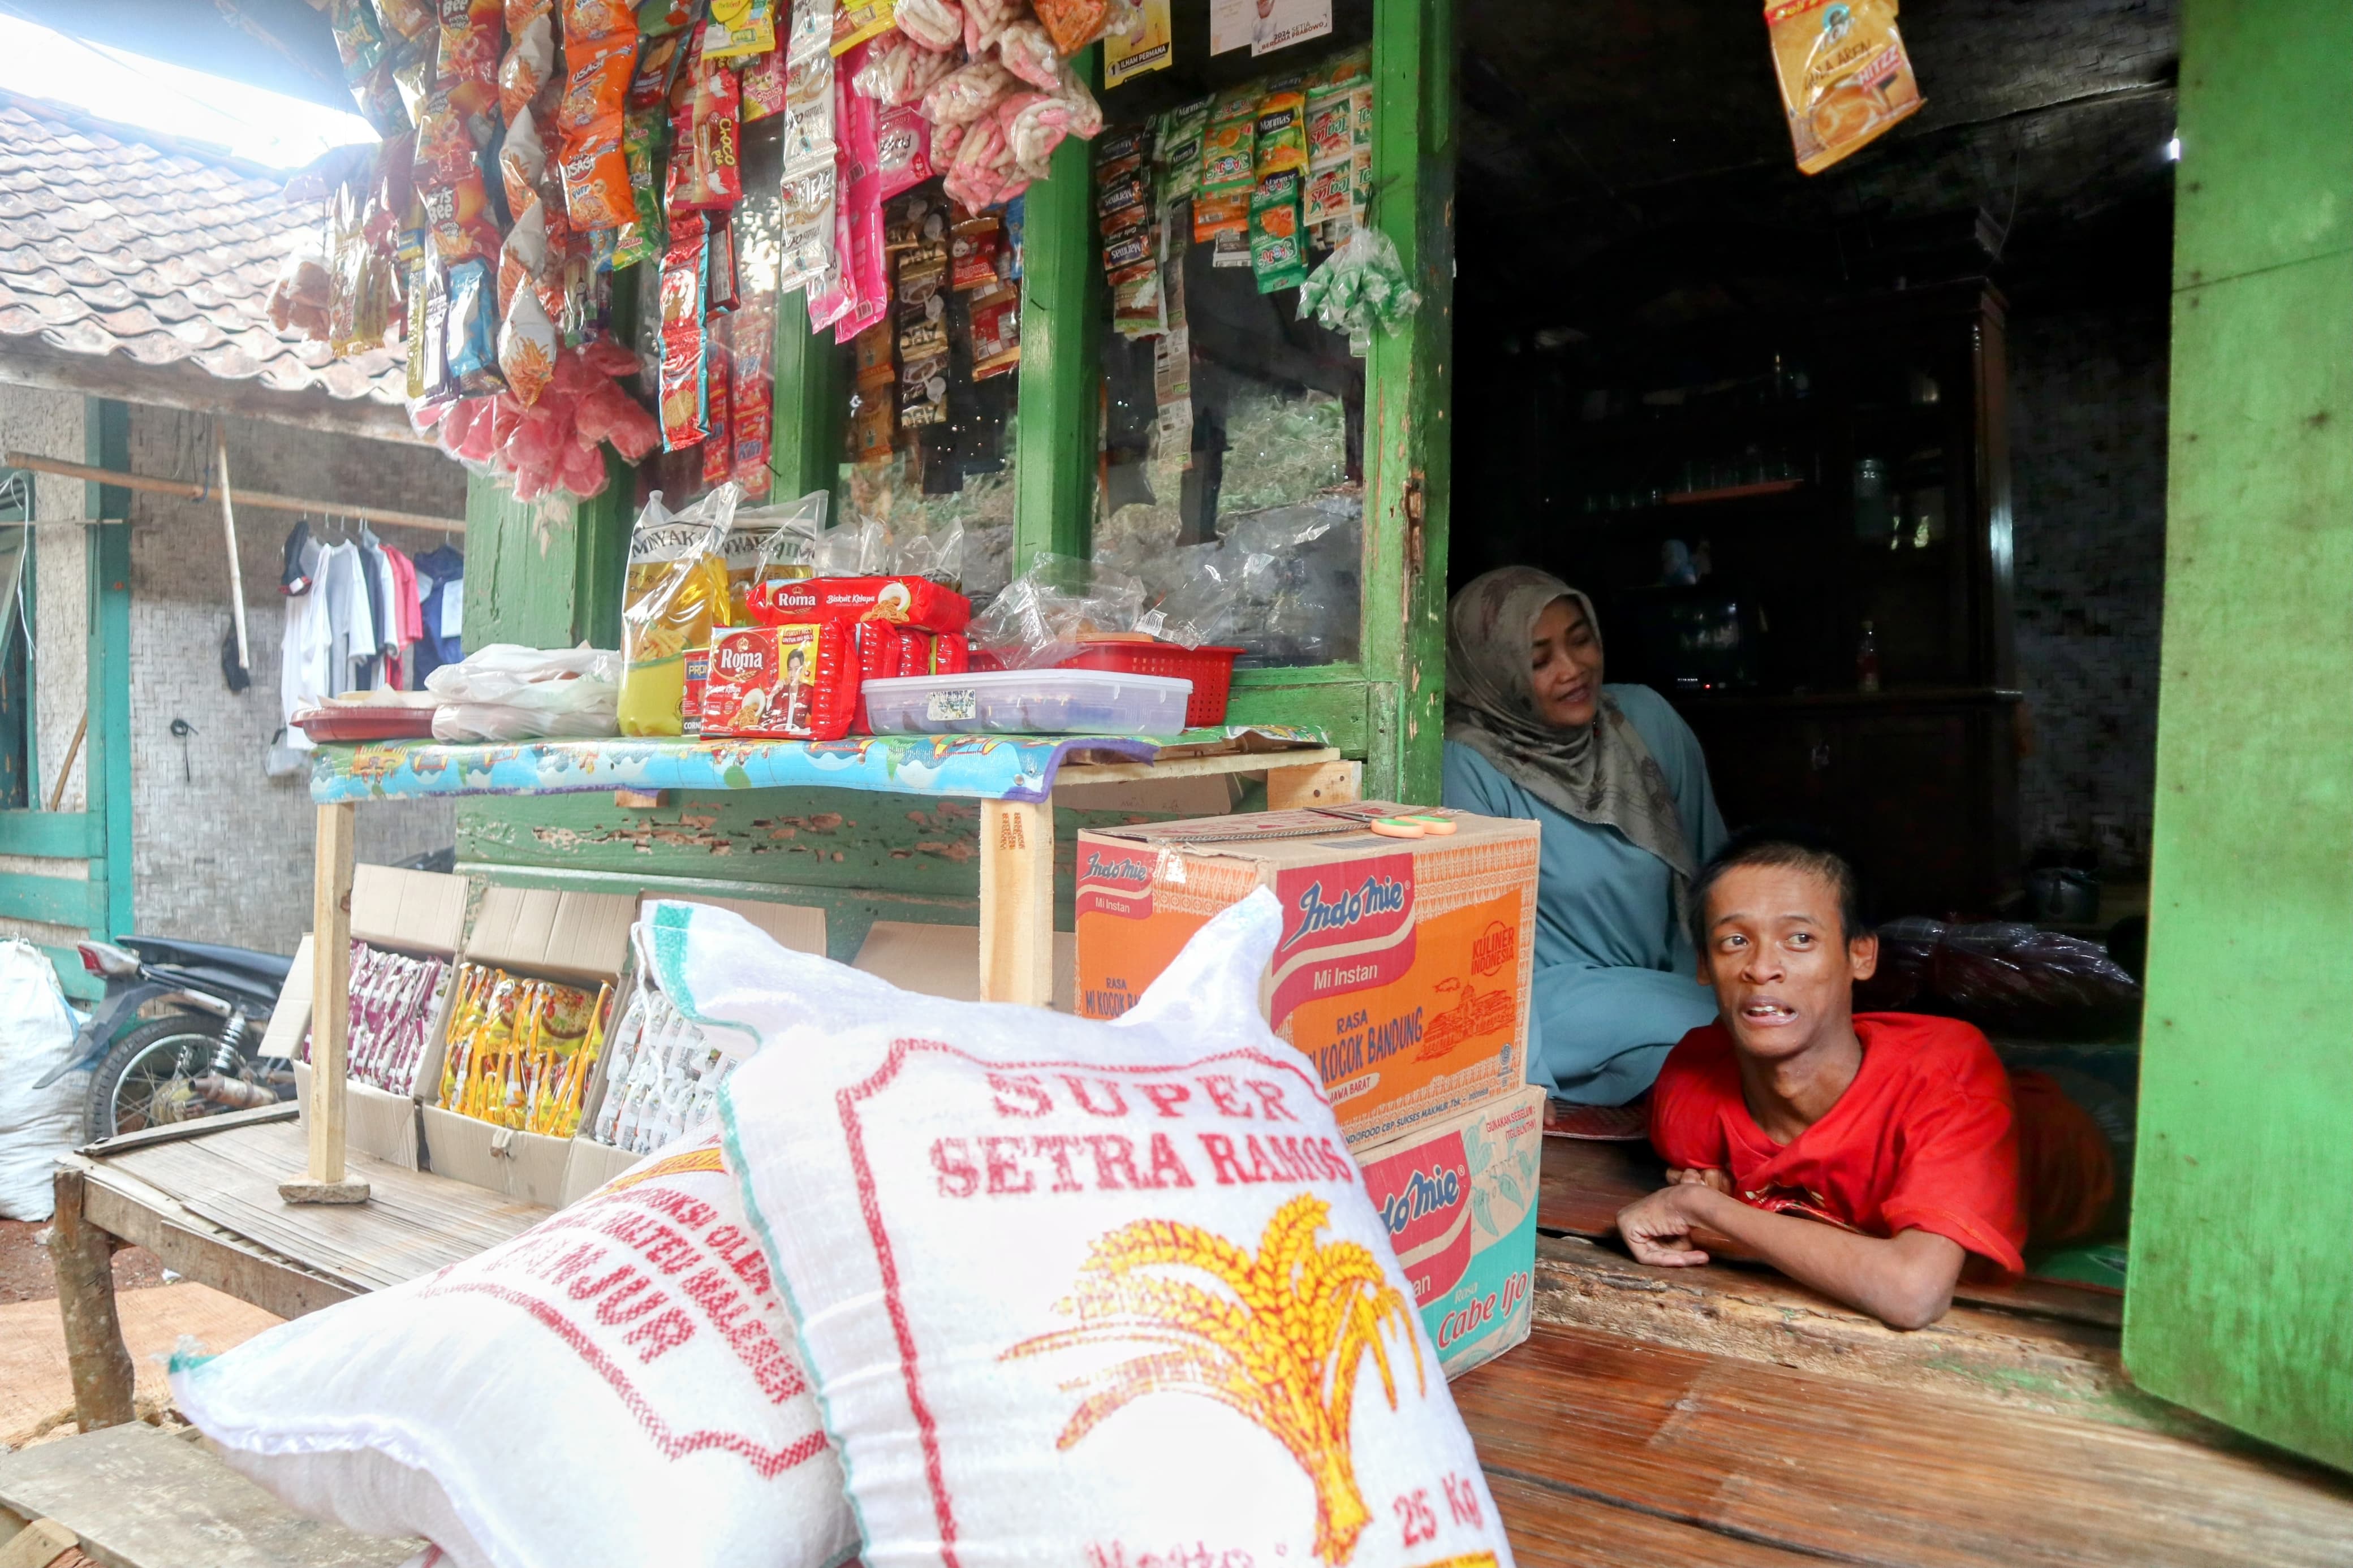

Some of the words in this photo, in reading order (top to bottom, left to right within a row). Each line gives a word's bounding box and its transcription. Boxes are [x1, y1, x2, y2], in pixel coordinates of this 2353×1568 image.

[1261, 36, 1291, 50] BERSAMA
[1292, 21, 1324, 39] PRABOWO
[1274, 29, 1291, 40] 2024
[1121, 55, 1138, 68] ILHAM
[1139, 45, 1166, 62] PERMANA
[1838, 38, 1872, 63] AREN
[1111, 64, 1116, 75] 1
[1260, 113, 1291, 131] Marimas
[719, 118, 736, 166] Choco
[564, 153, 596, 180] USAGI
[711, 149, 723, 166] Pie
[428, 203, 453, 223] Bee
[1111, 241, 1141, 260] Marimas
[901, 405, 937, 429] ABC
[778, 594, 816, 607] Roma
[826, 595, 851, 604] Biskuit
[852, 594, 876, 604] Kelapa
[721, 648, 764, 669] Roma
[1095, 896, 1105, 909] Mi
[1106, 898, 1131, 914] Instan
[1472, 926, 1515, 960] KULINER
[1471, 943, 1515, 977] INDONESIA
[1106, 977, 1127, 991] RASA
[1313, 970, 1331, 991] Mi
[1334, 964, 1378, 987] Instan
[1085, 990, 1096, 1014] MI
[1097, 991, 1126, 1018] KOCOK
[1337, 1009, 1369, 1035] RASA
[1321, 1034, 1364, 1083] KOCOK
[1368, 1006, 1423, 1064] BANDUNG
[984, 1070, 1300, 1122] SUPER
[1330, 1087, 1349, 1104] JAWA
[1350, 1076, 1371, 1095] BARAT
[1346, 1125, 1380, 1144] NDOFOOD
[1381, 1121, 1395, 1133] CBP
[1396, 1112, 1420, 1128] SUKSES
[1420, 1102, 1449, 1118] MAKMUR
[1450, 1098, 1461, 1108] Tbk
[1485, 1114, 1511, 1134] GUNAKAN
[1510, 1107, 1533, 1122] SEBELUM
[929, 1131, 1195, 1198] SETRA
[1196, 1131, 1353, 1186] RAMOS
[1454, 1281, 1477, 1304] Rasa
[1437, 1291, 1498, 1349] Cabe
[1501, 1270, 1529, 1317] Ijo
[1392, 1486, 1438, 1549] 25
[1441, 1471, 1484, 1530] Kg
